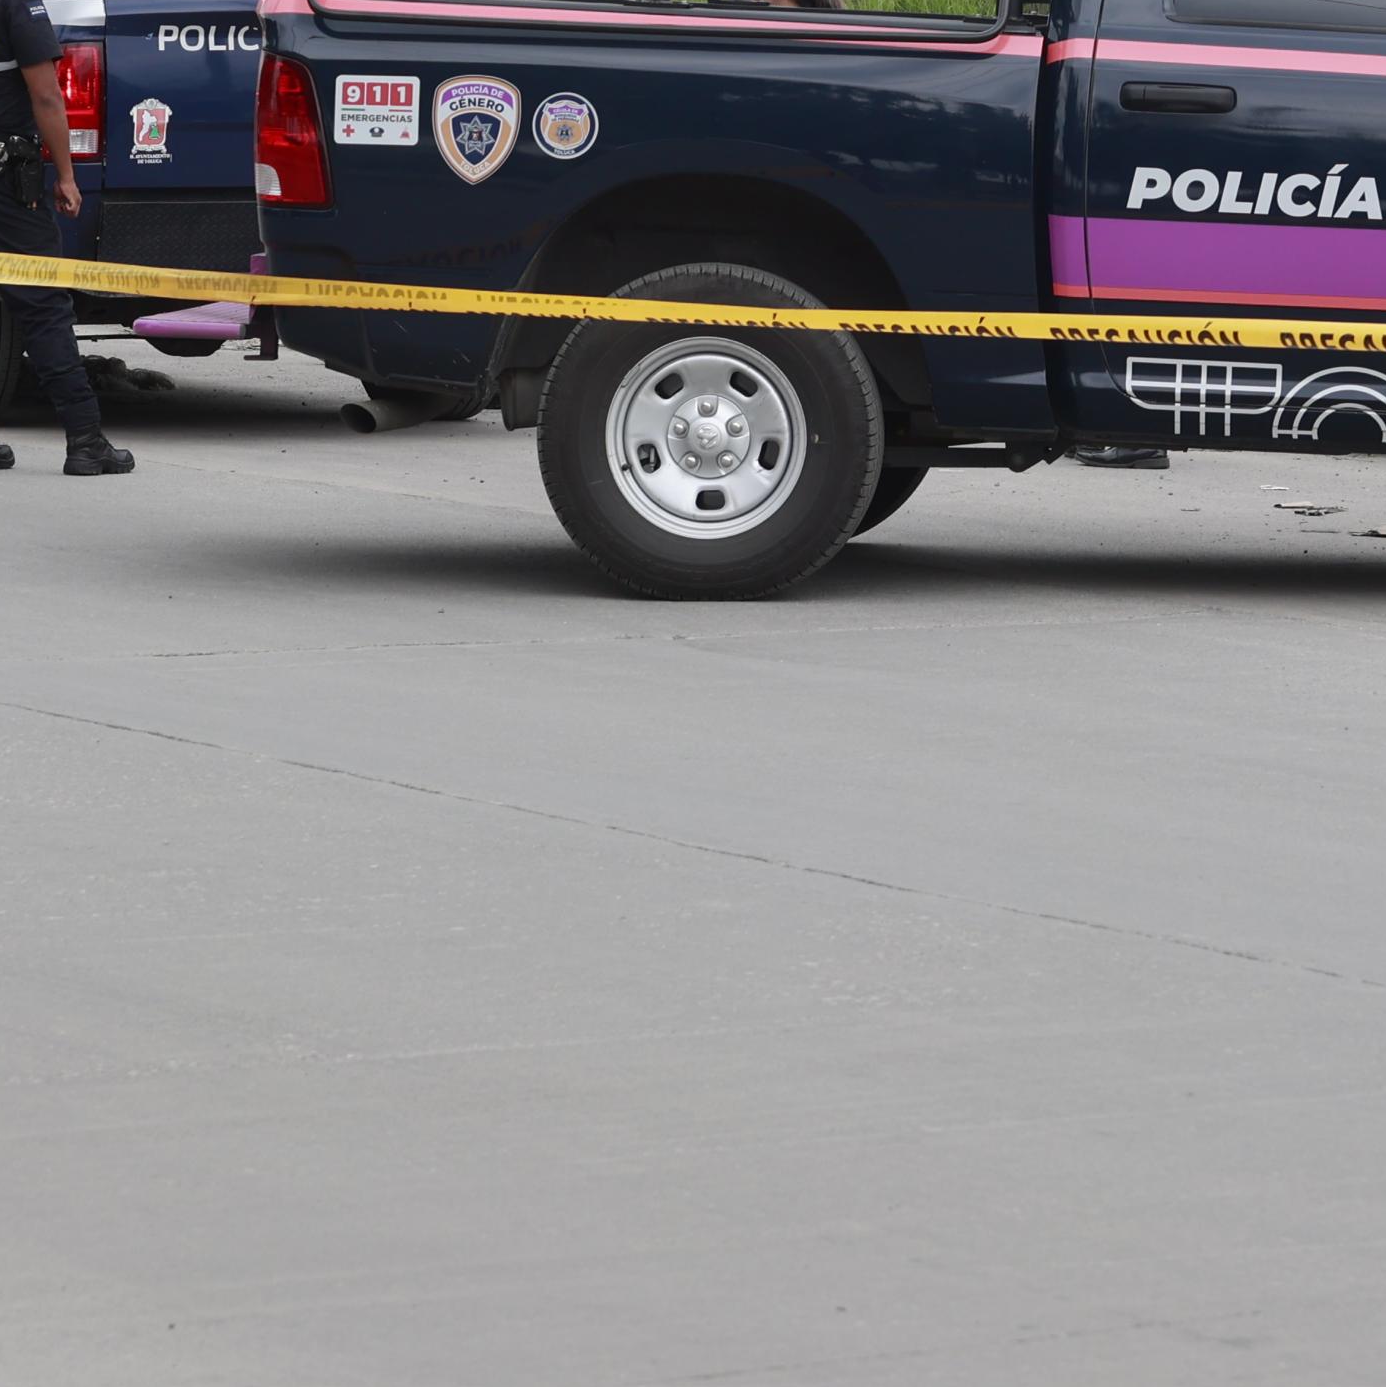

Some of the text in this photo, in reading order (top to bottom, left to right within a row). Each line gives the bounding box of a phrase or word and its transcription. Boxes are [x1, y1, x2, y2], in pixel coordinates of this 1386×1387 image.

[451, 84, 505, 99] POLICÍA DE
[449, 96, 505, 114] GÉNERO
[341, 114, 413, 123] EMERGENCIAS
[1126, 164, 1383, 220] POLICÍA
